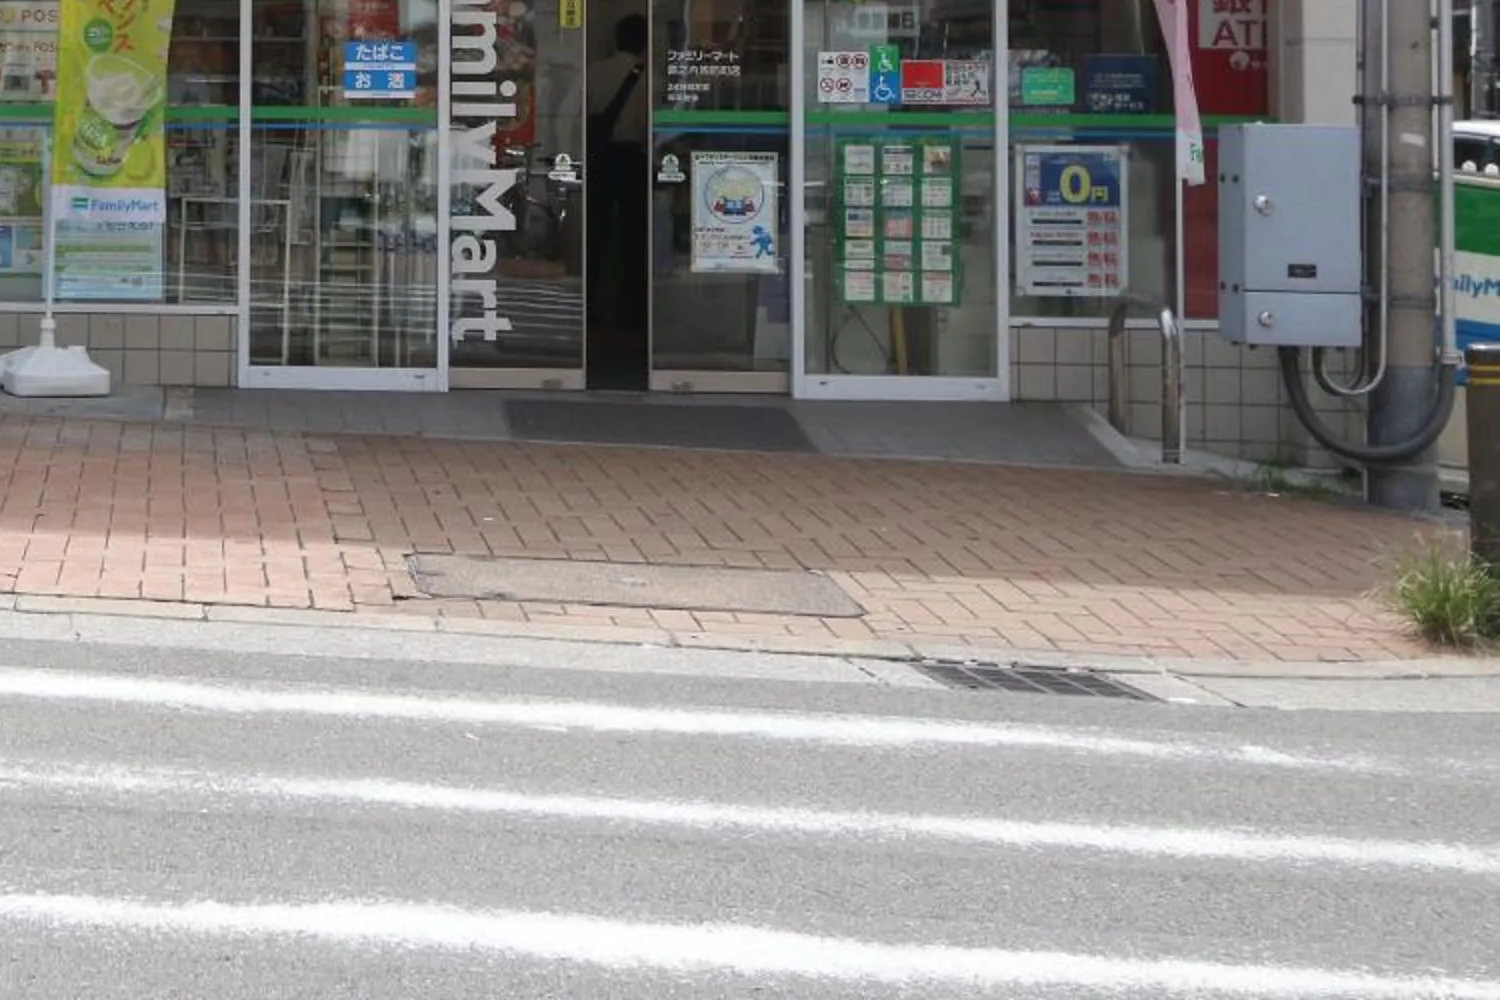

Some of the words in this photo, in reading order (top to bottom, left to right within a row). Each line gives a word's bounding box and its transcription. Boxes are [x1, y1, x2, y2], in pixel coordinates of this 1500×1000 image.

[1212, 19, 1267, 47] AT
[355, 44, 405, 61] たばこ
[90, 198, 160, 213] FamilyMart
[1454, 273, 1500, 299] ilyM
